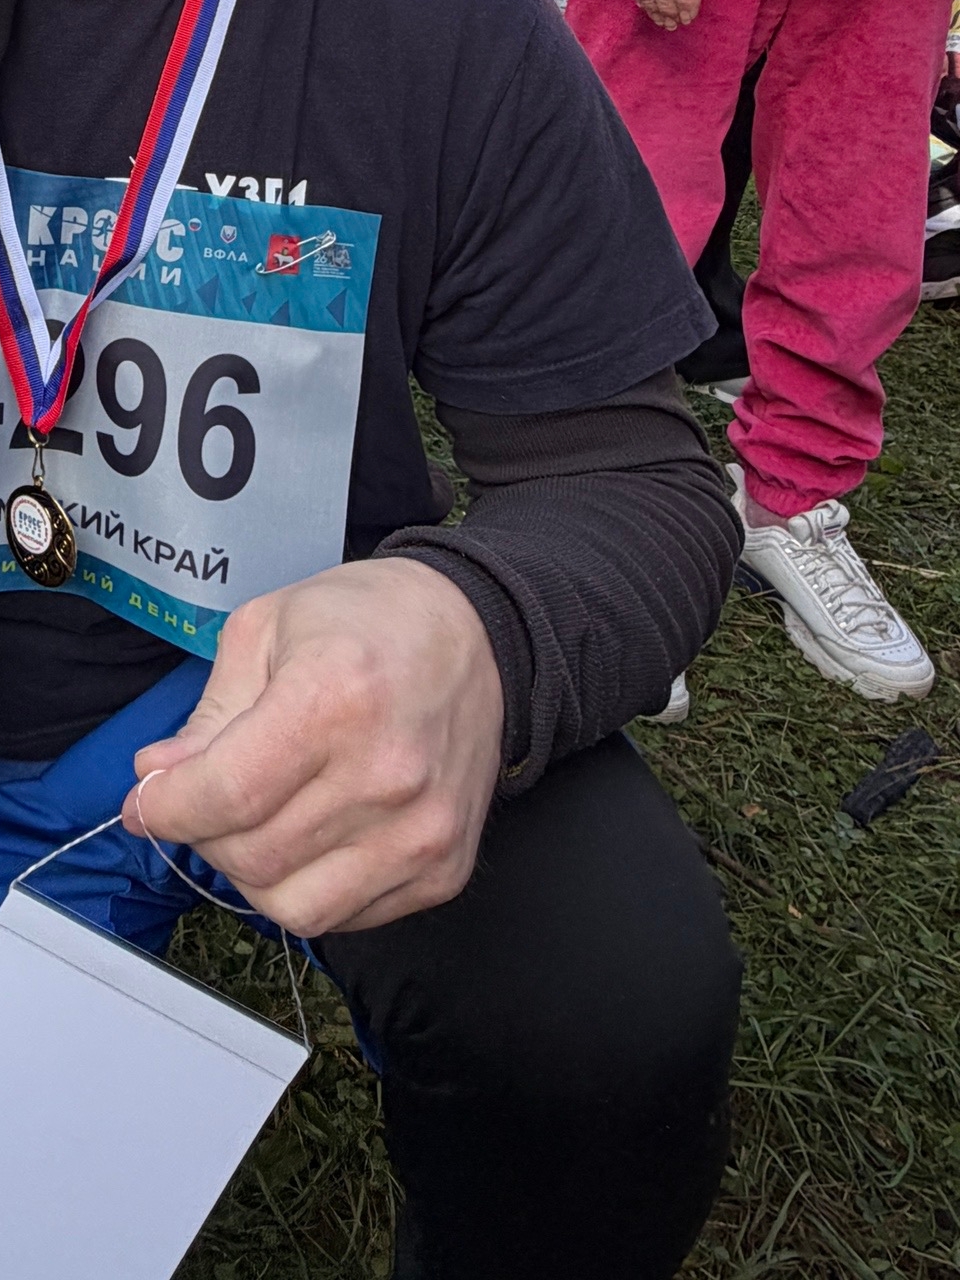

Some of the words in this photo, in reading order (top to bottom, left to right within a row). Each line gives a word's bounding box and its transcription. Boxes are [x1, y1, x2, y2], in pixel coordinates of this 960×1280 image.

[27, 204, 186, 263] КРОС
[203, 246, 249, 264] ВФЛА
[133, 528, 230, 585] КРАЙ
[128, 592, 197, 636] ДЕНЬ
